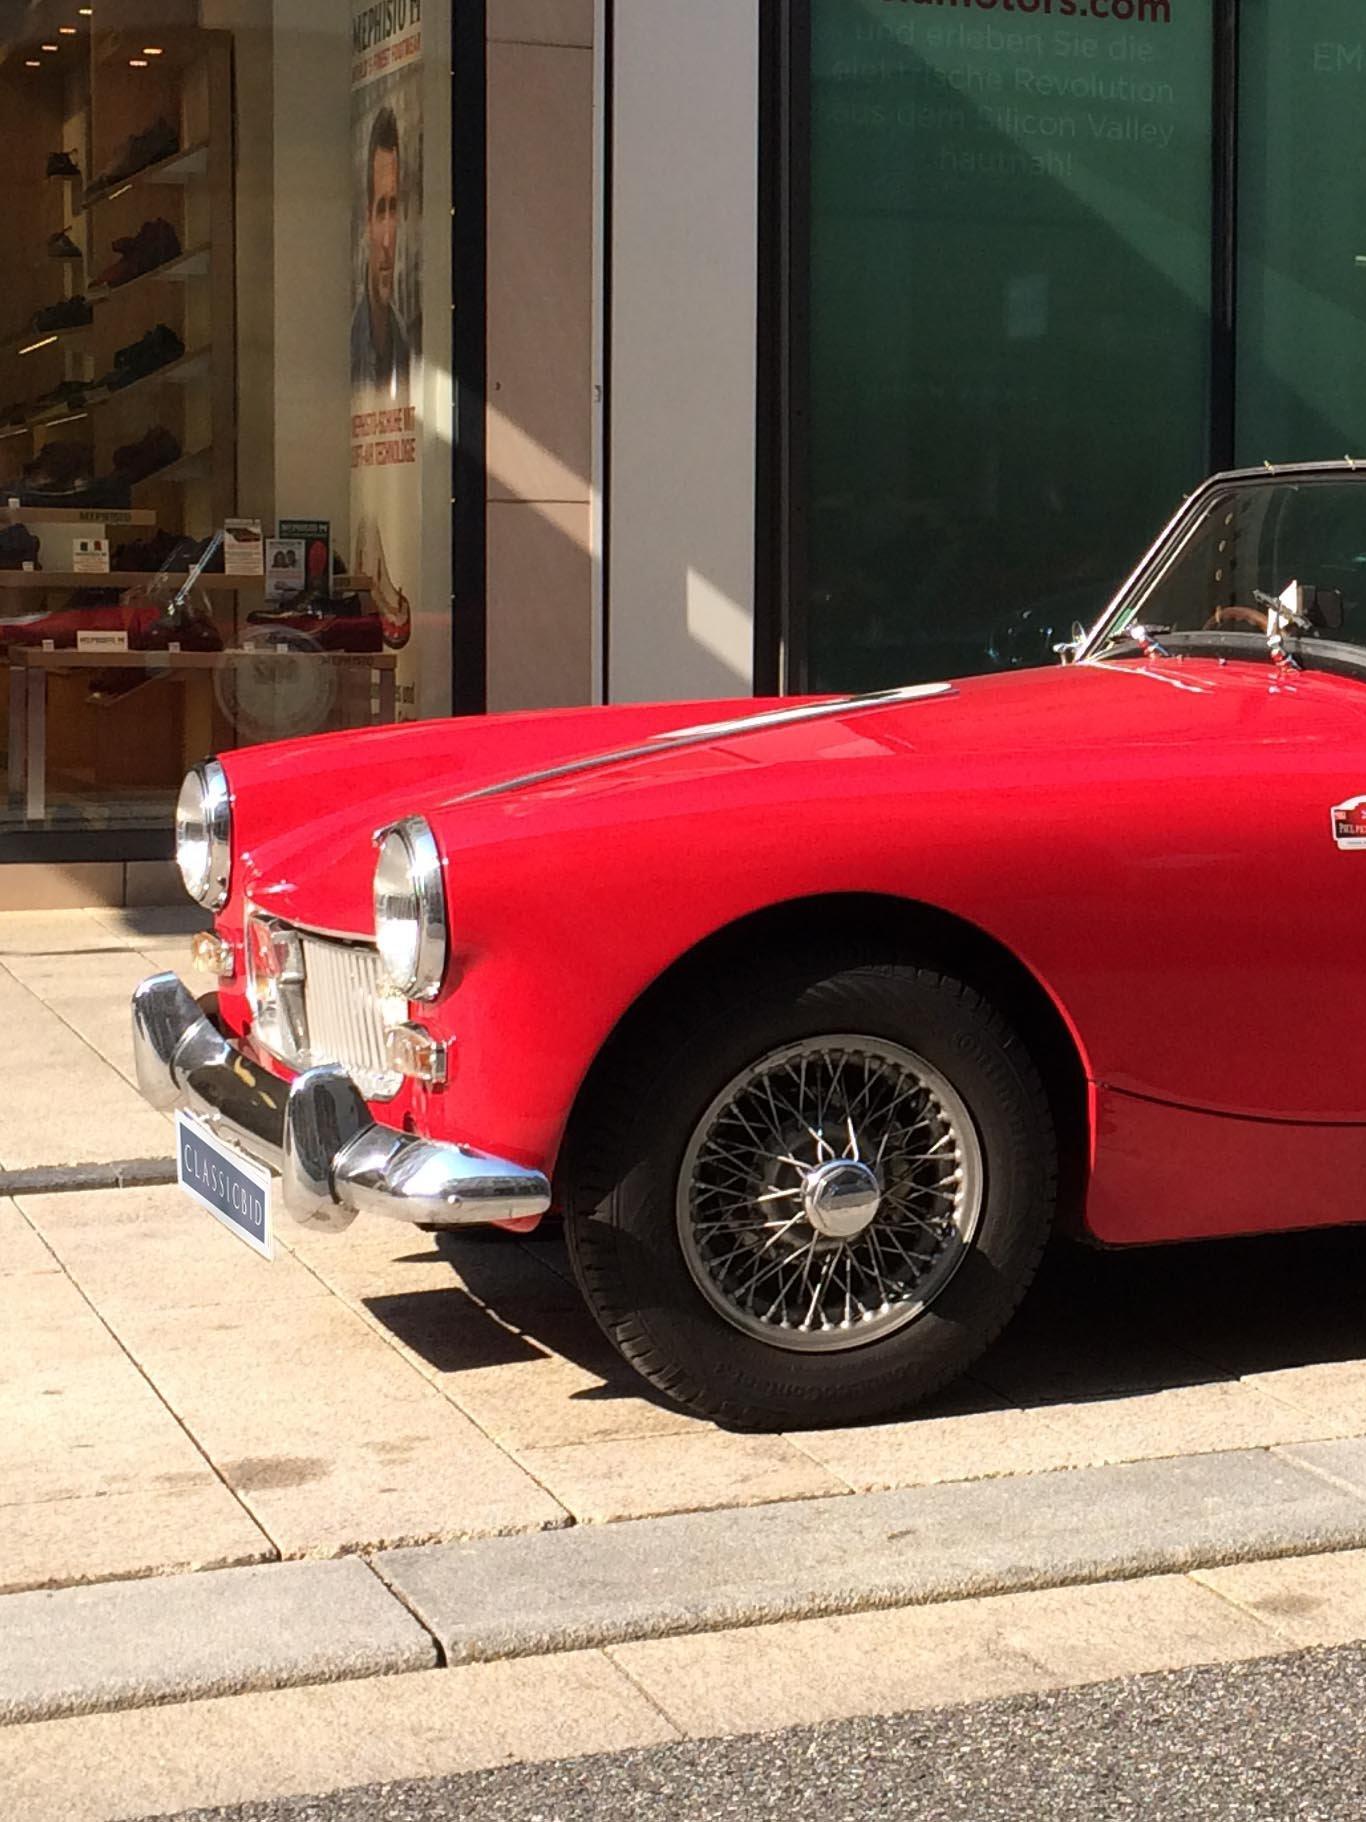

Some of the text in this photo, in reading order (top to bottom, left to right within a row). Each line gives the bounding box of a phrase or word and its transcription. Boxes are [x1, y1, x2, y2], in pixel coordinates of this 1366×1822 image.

[926, 22, 1044, 55] erleben
[1054, 30, 1099, 59] Sie
[1108, 34, 1154, 63] die
[1014, 67, 1175, 105] Revolution
[978, 106, 1077, 138] Silicon
[1086, 112, 1176, 149] Valley
[184, 1144, 262, 1227] CLASSICBID
